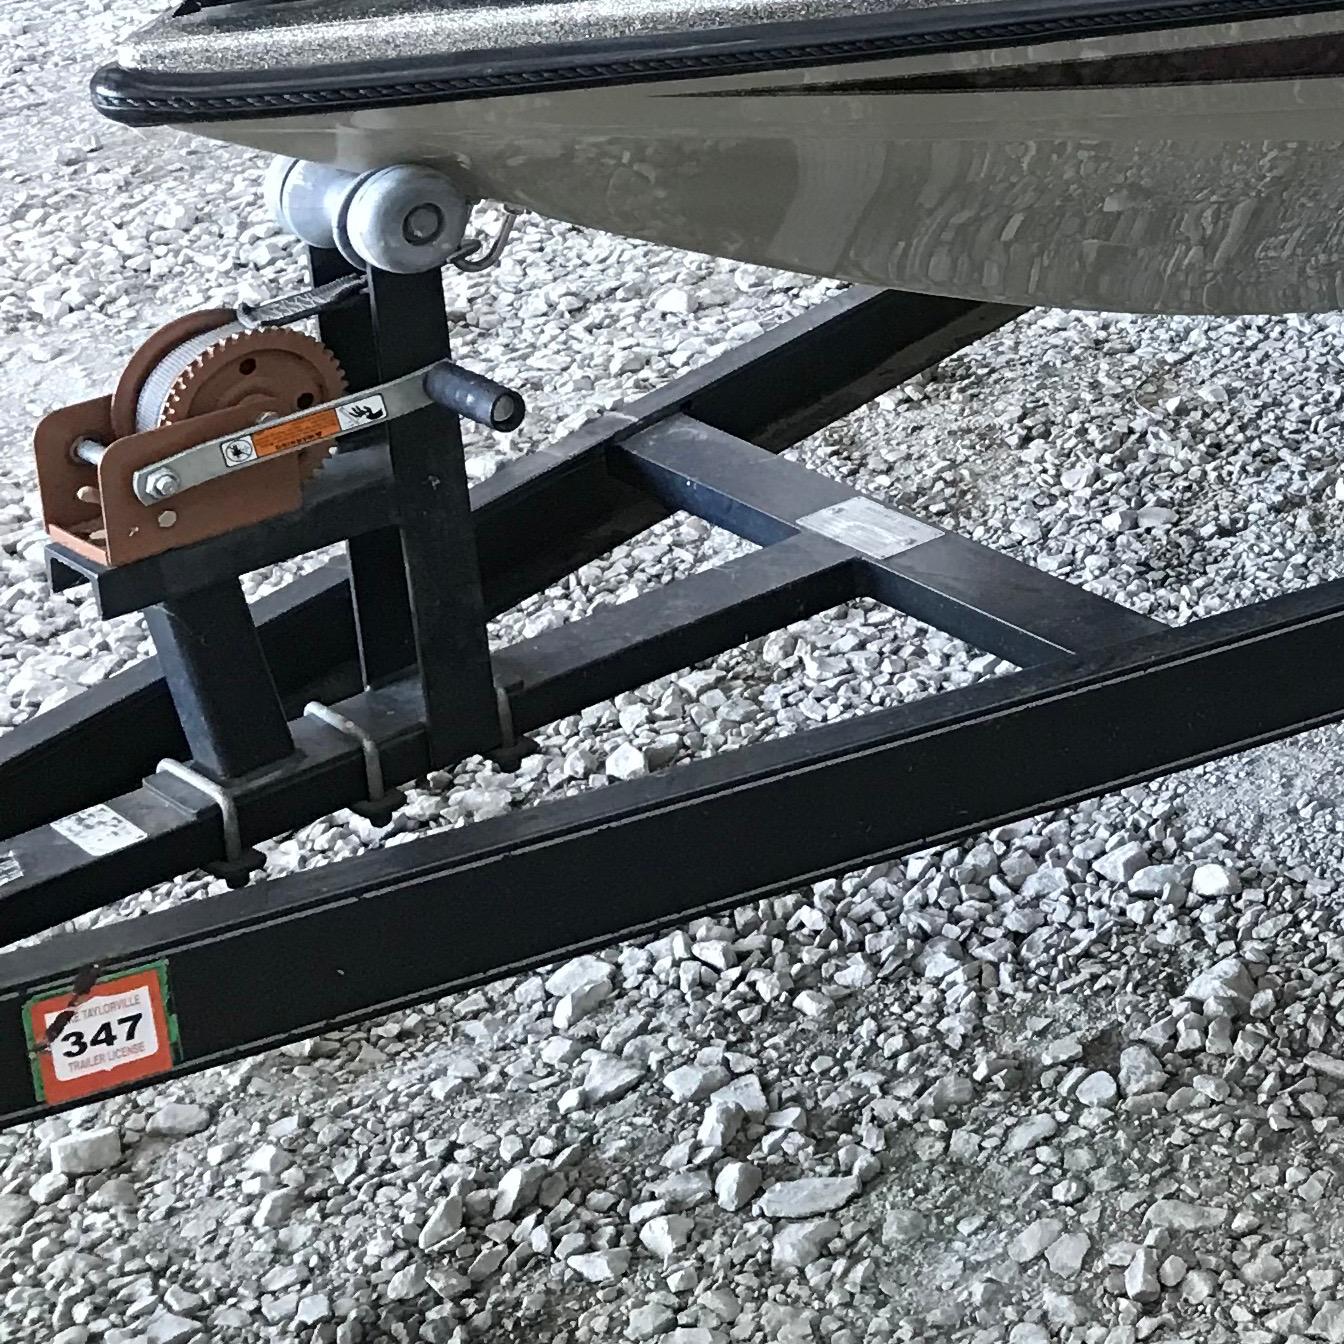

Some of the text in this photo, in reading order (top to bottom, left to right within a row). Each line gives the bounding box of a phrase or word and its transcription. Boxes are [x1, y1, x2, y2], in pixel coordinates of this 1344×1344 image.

[82, 994, 141, 1019] TAYLORVILLE
[61, 1013, 142, 1058] 347
[68, 1041, 145, 1073] TRAILER LICENSE
